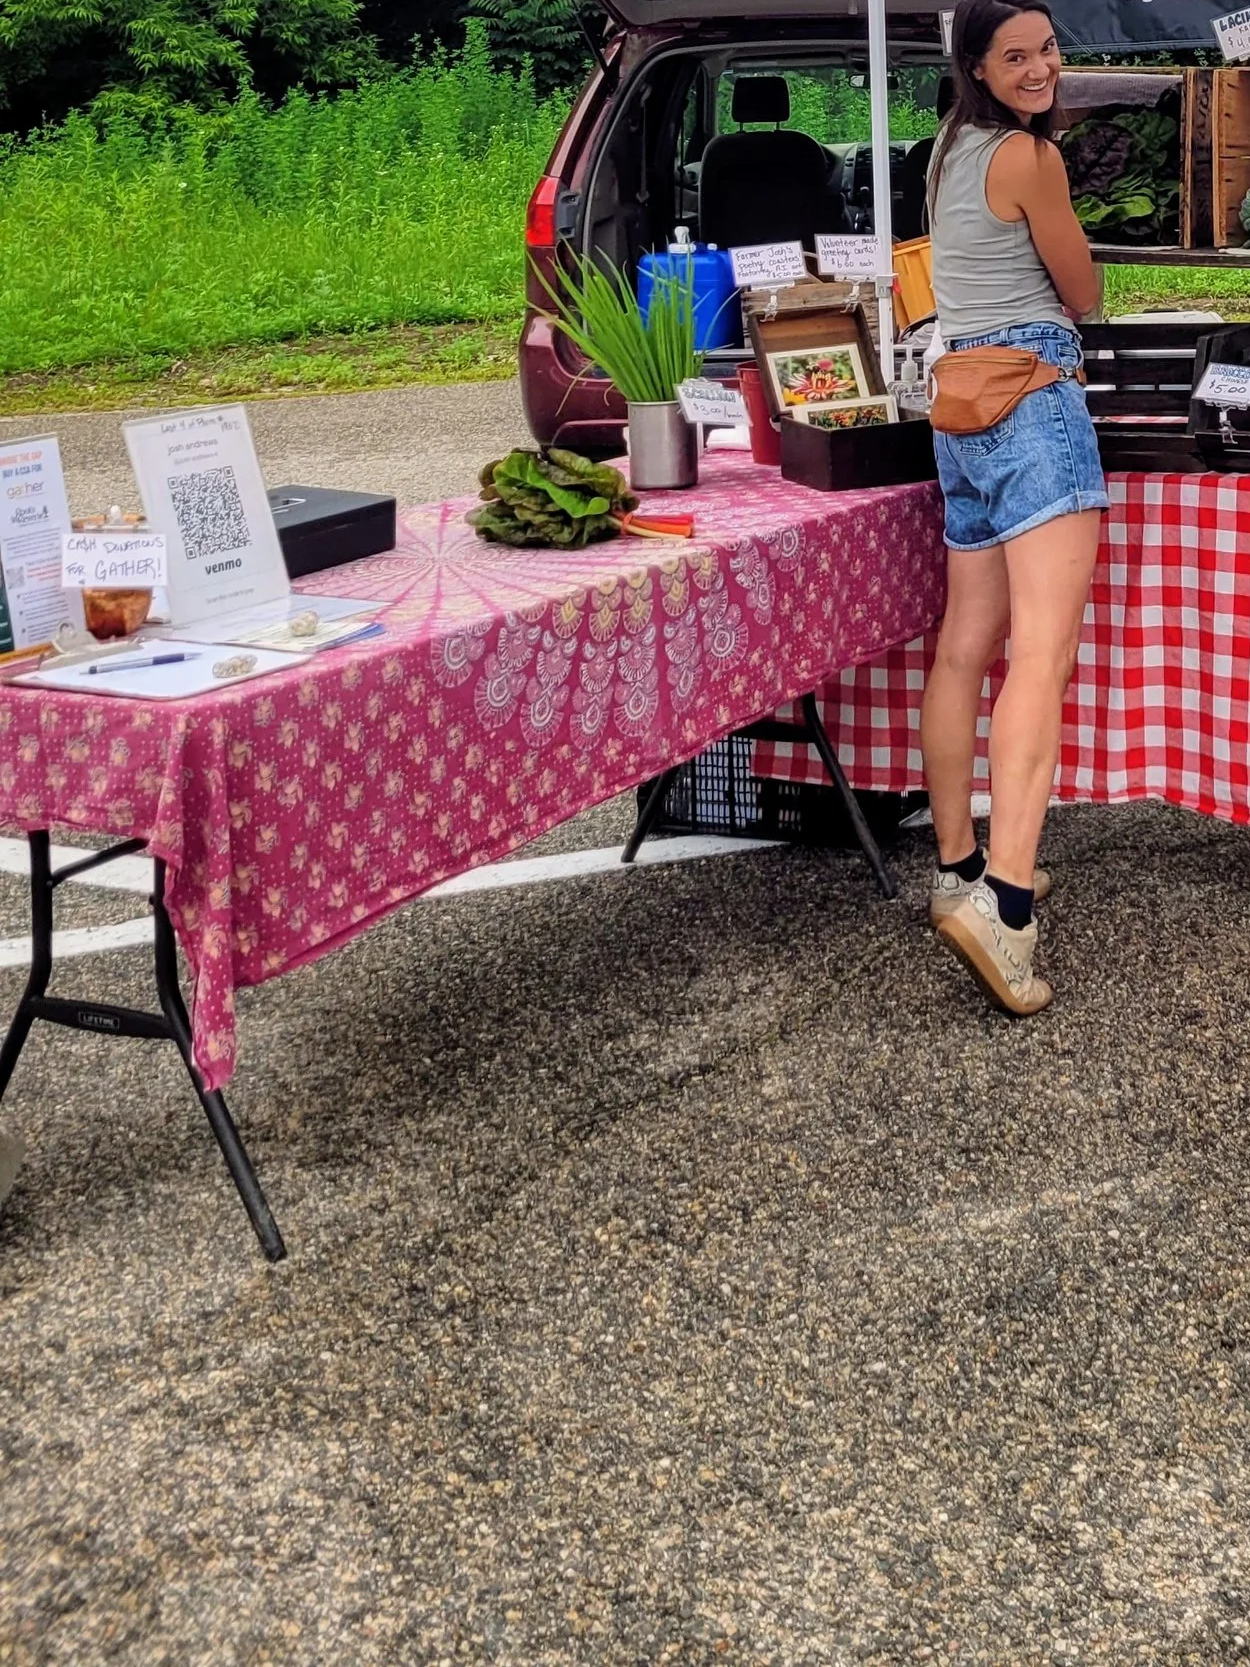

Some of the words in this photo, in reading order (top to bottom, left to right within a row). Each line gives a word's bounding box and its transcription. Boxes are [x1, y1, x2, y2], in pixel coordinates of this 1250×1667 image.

[185, 438, 219, 451] andrews
[95, 557, 163, 582] GATHER!
[204, 558, 242, 575] venmo
